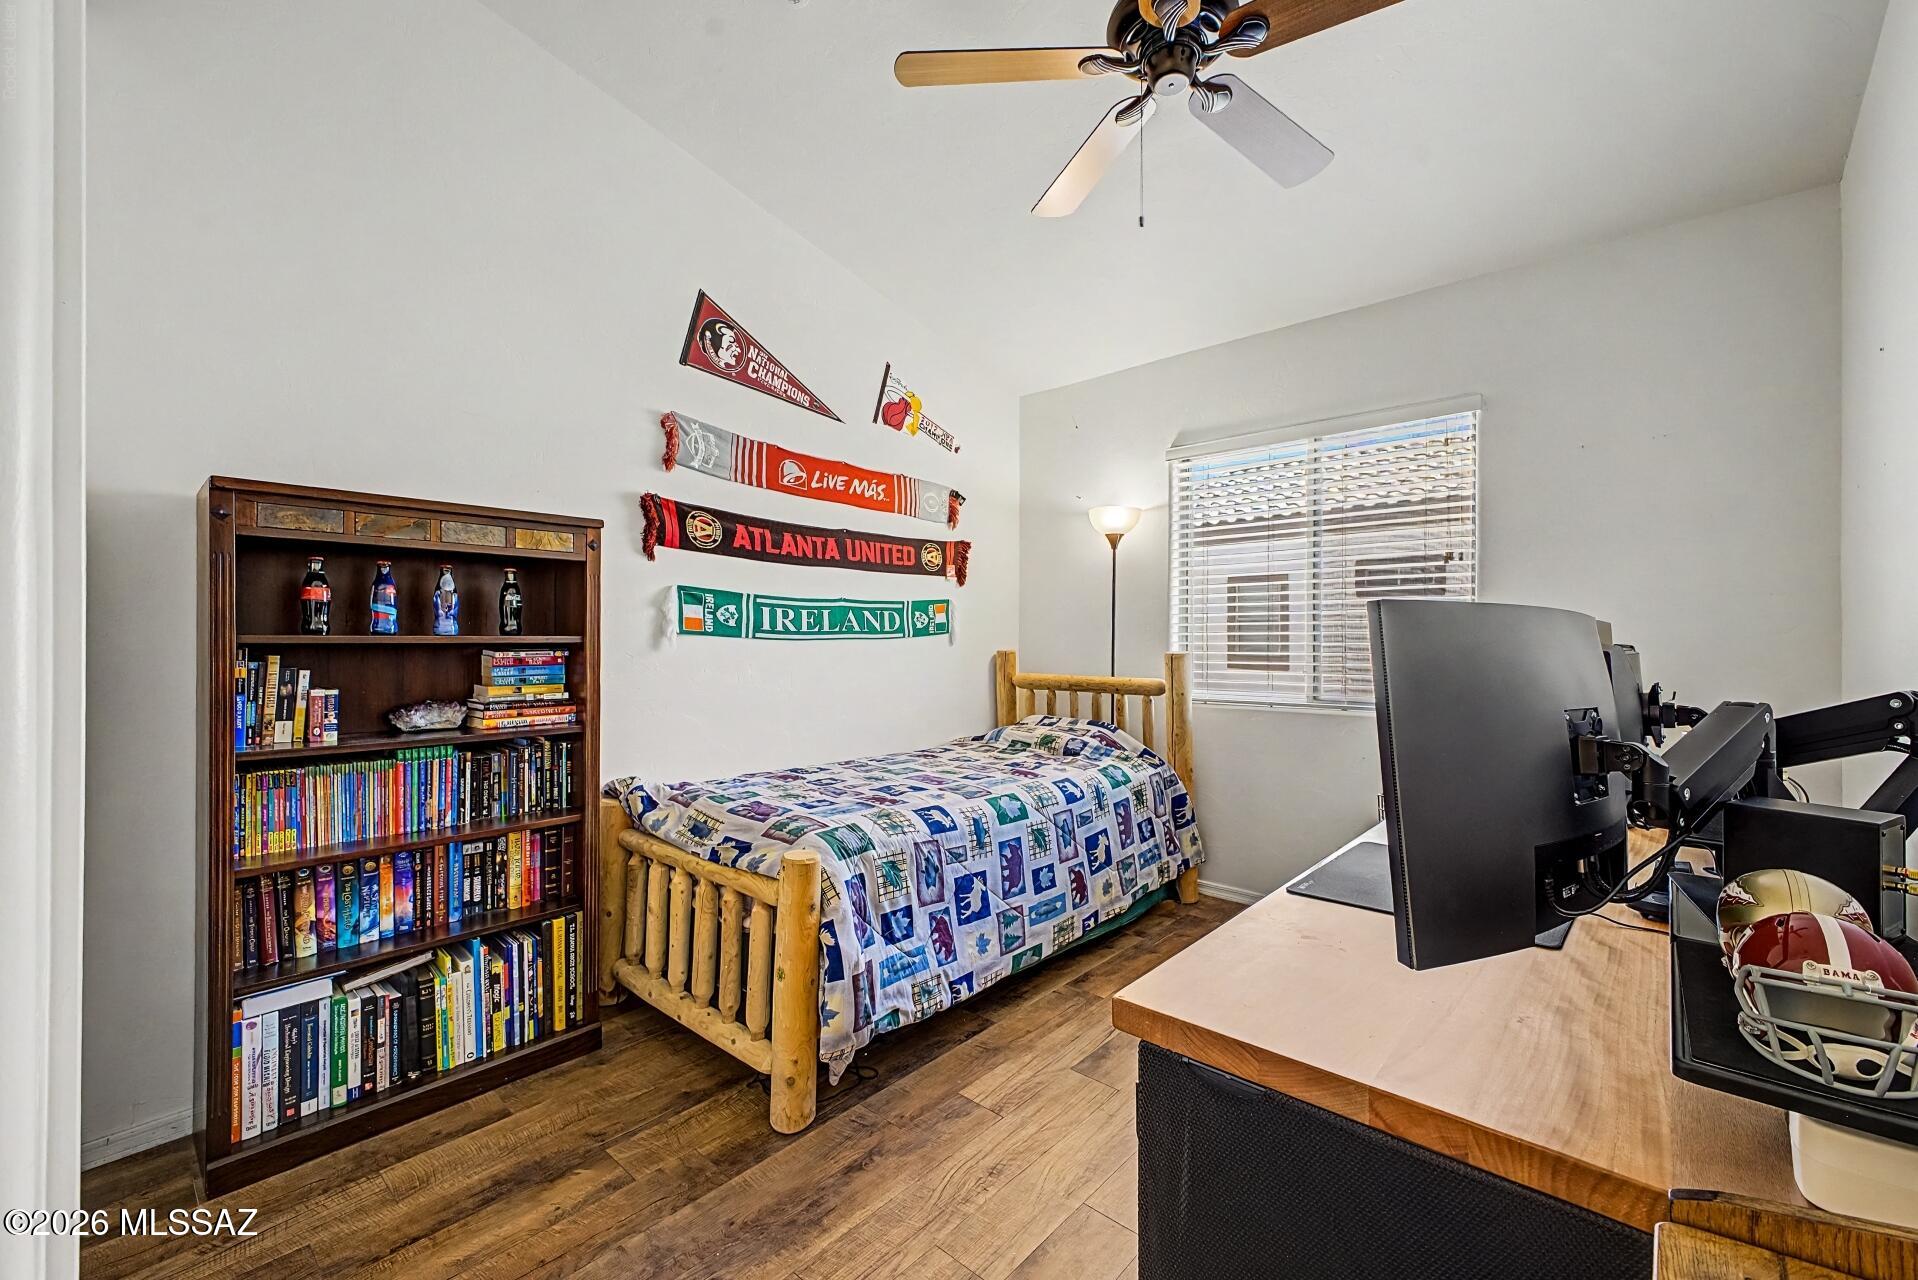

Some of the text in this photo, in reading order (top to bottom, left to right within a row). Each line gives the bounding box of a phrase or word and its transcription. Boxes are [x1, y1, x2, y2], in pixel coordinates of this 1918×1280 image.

[748, 345, 788, 381] NATIONAL
[748, 361, 811, 407] CHAMPIONS
[733, 523, 841, 561] ATLANTA
[844, 538, 916, 567] UNITED
[704, 593, 714, 632] IRELAND
[759, 606, 901, 633] IRELAND
[1822, 968, 1860, 981] BAMA
